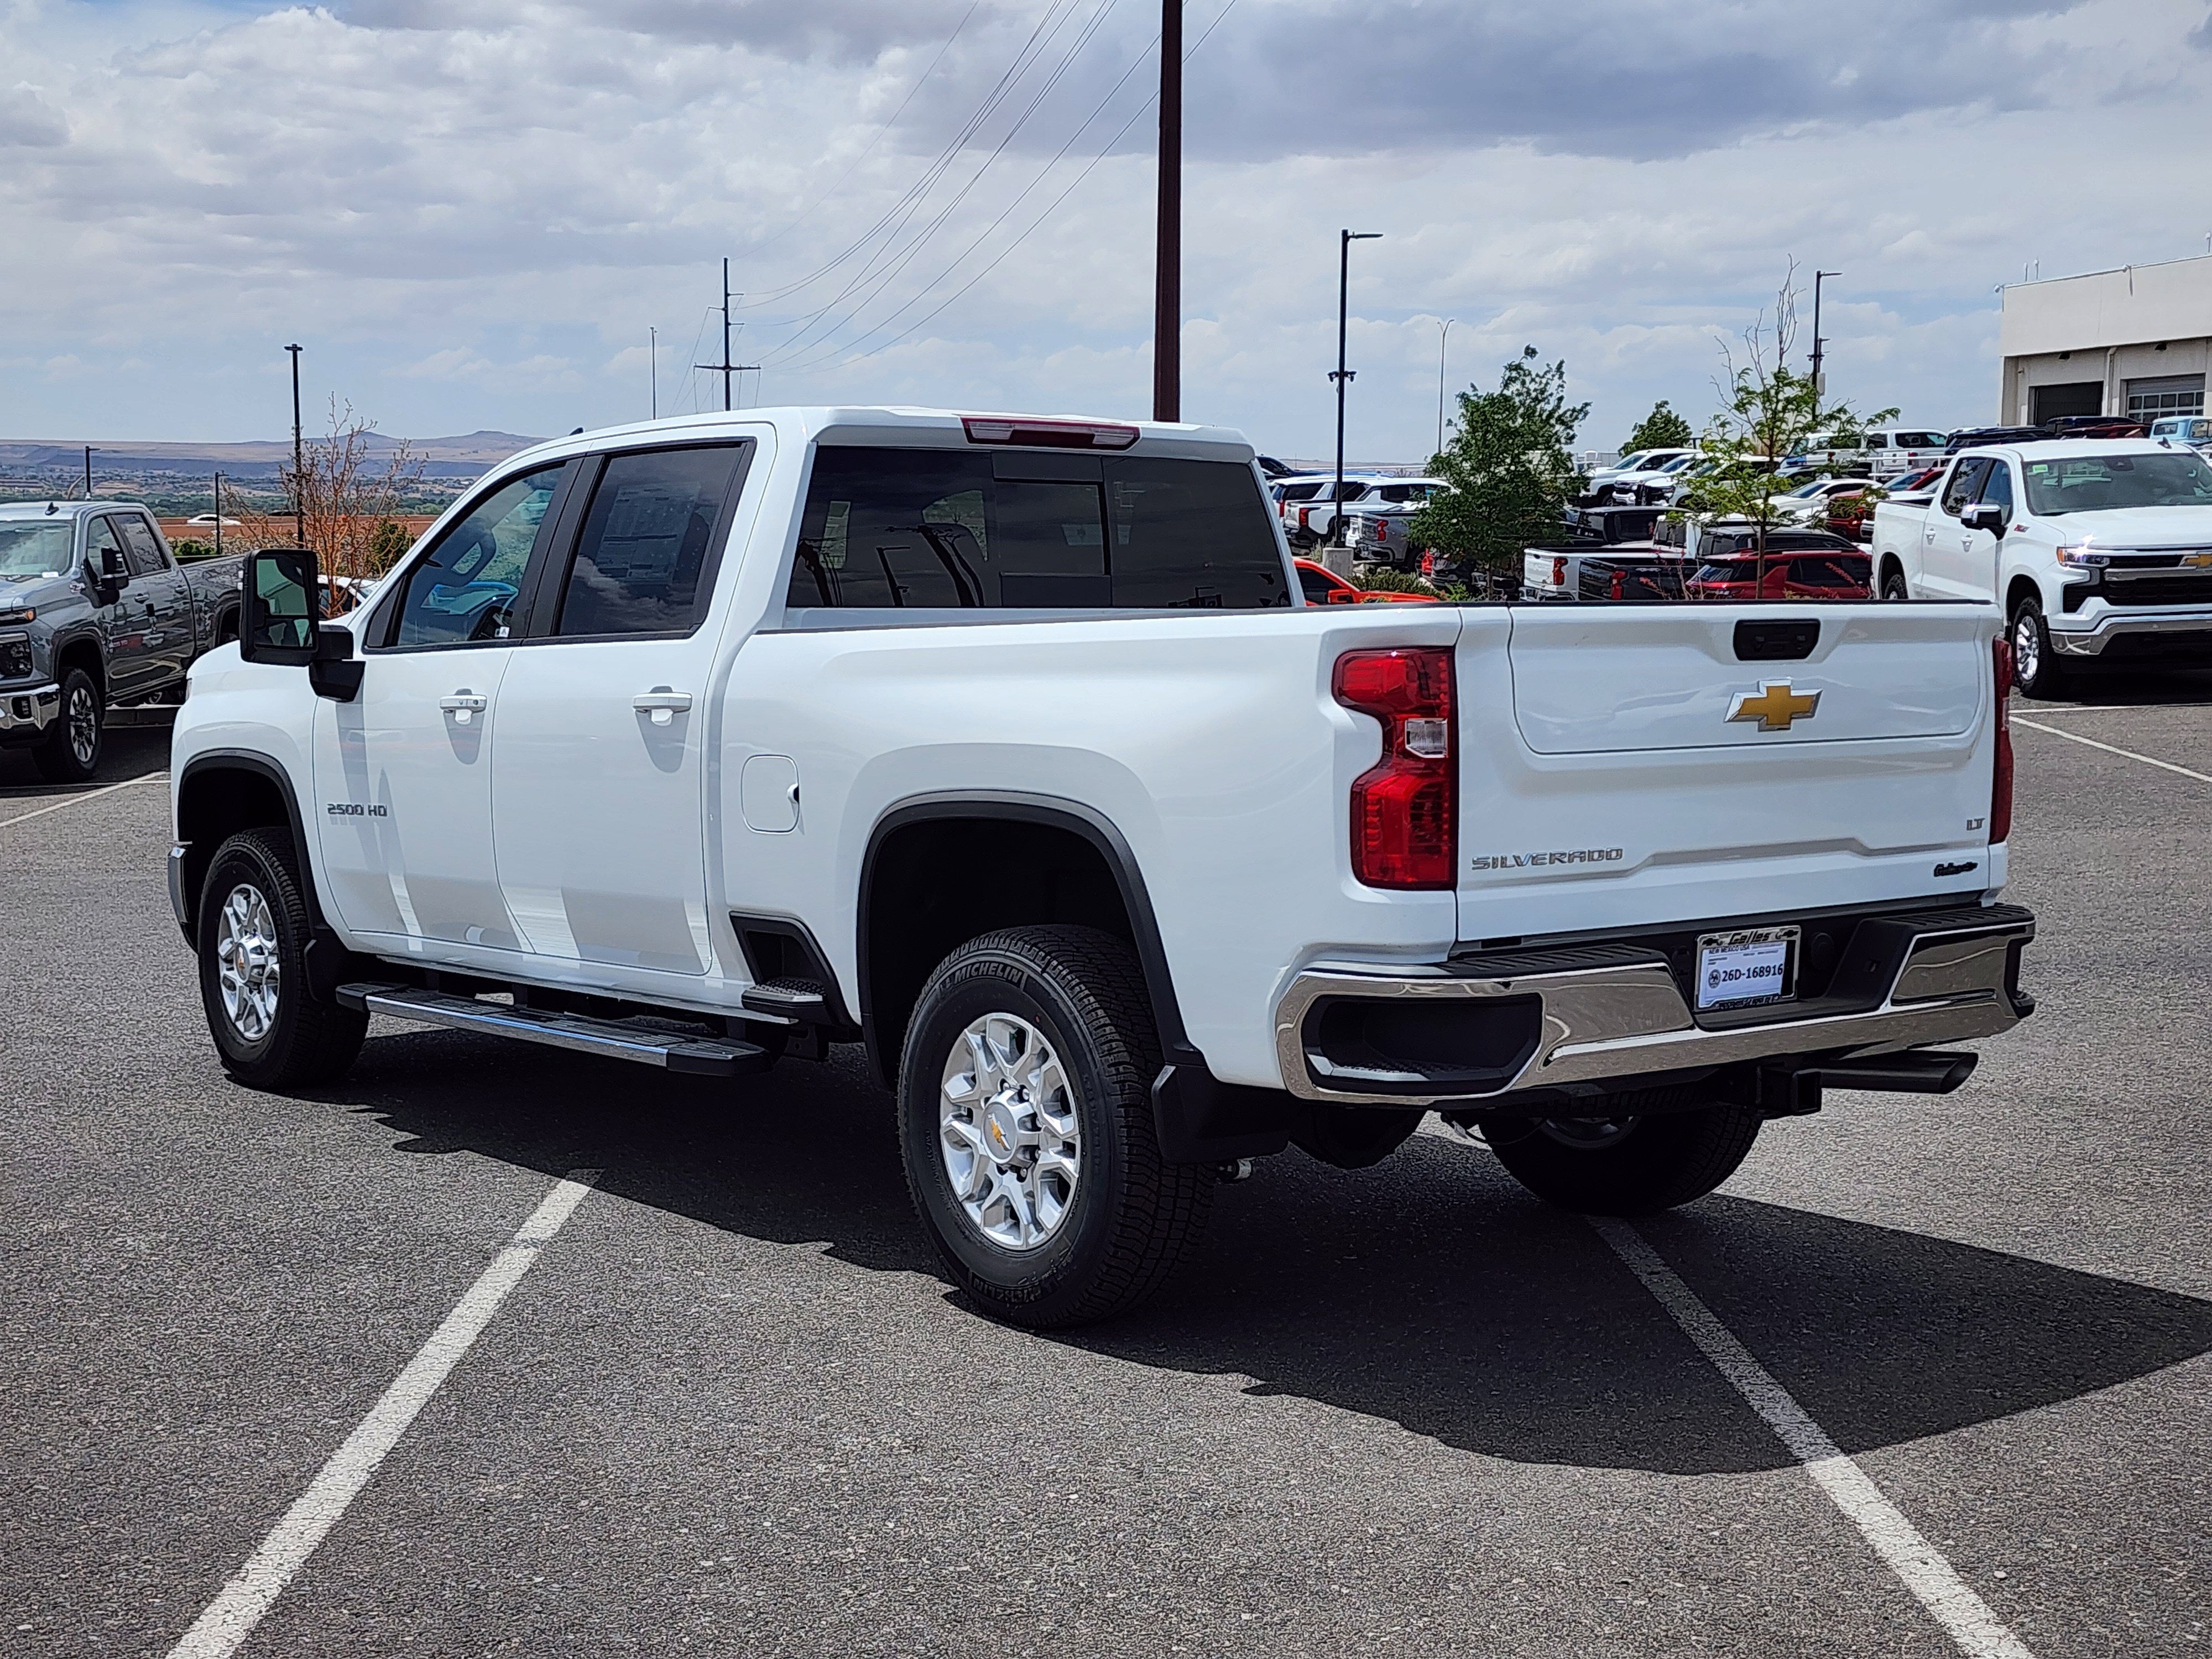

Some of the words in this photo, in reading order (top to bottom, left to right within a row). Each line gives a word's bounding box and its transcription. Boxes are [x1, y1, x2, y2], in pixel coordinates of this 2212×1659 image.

[327, 804, 364, 816] 2500
[368, 805, 387, 817] HD
[1966, 818, 1985, 831] LT
[1471, 847, 1624, 870] SILVERADO
[954, 962, 1023, 985] MICHELIN
[1721, 963, 1783, 982] 26D-168916
